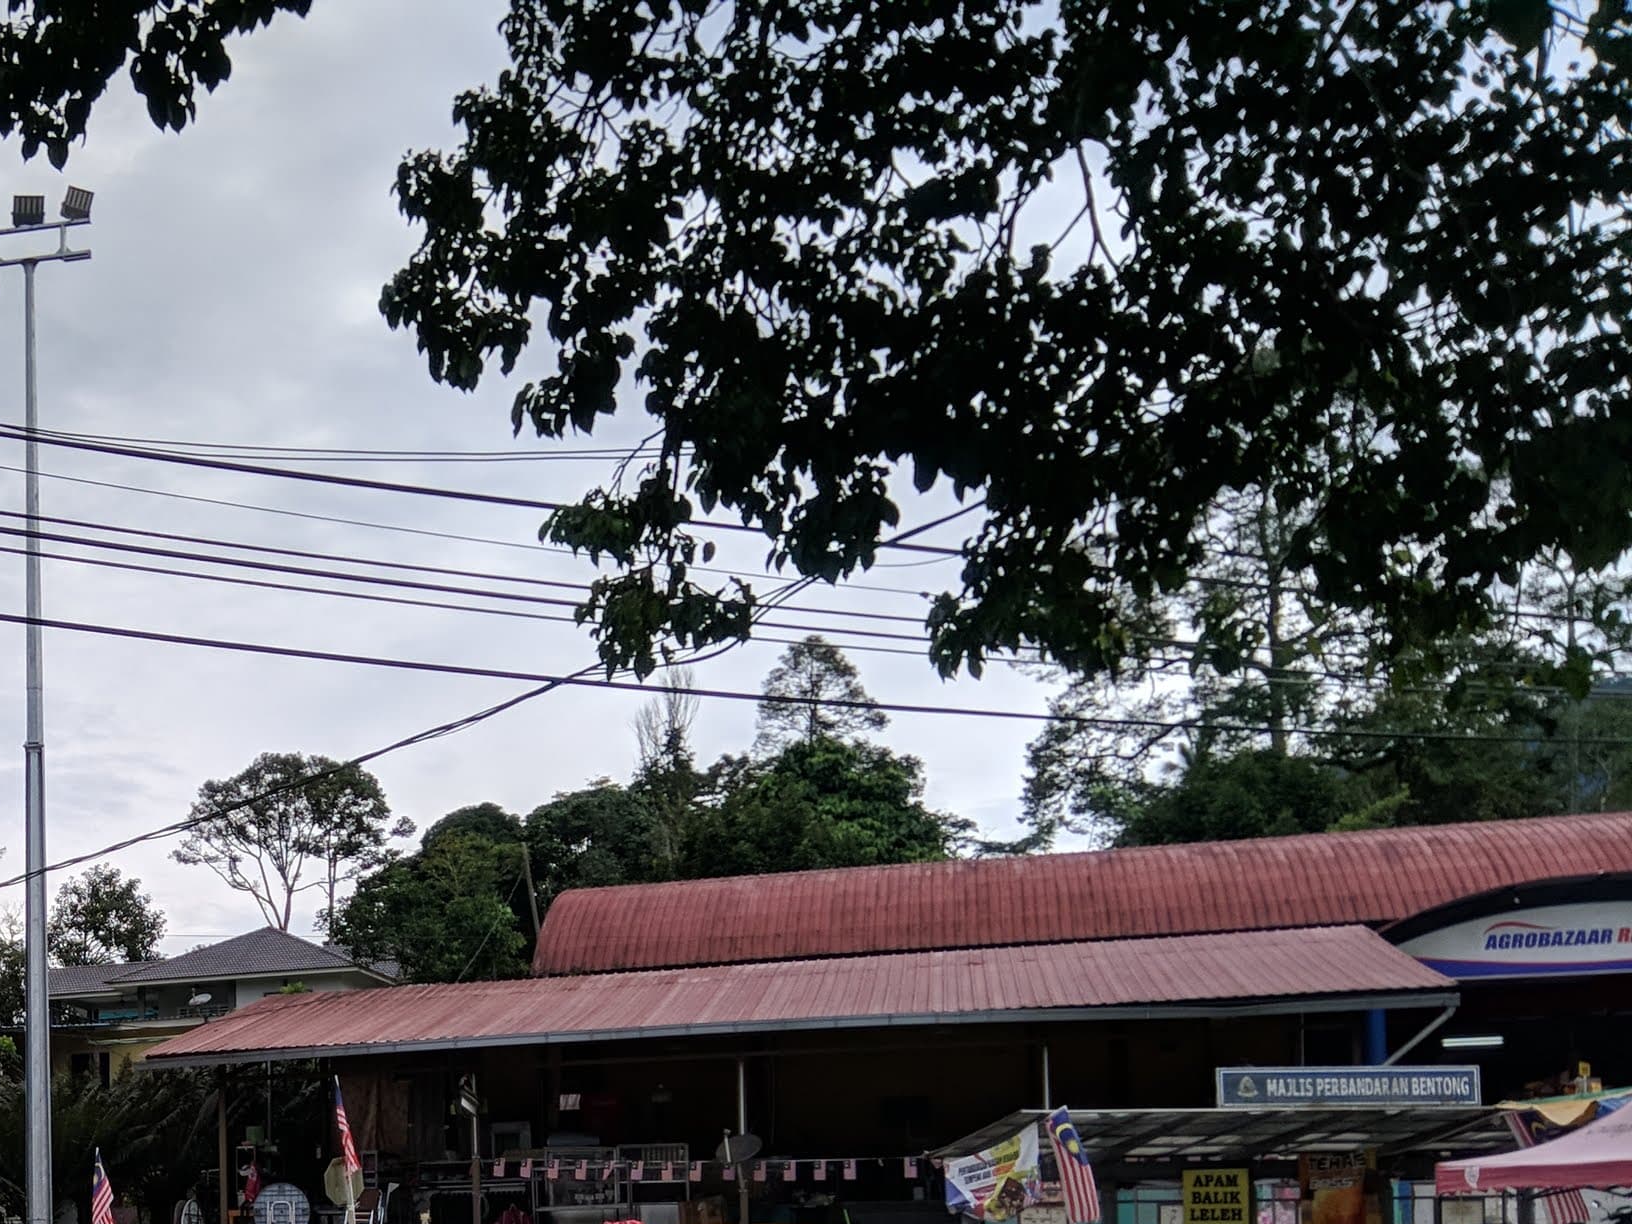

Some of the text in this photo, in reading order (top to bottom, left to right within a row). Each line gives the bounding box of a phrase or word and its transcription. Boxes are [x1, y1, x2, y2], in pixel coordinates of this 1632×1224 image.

[1485, 928, 1613, 950] AGROBAZAAR
[1267, 1076, 1469, 1096] MAJLIS PERBANDARAN BENTONG
[1193, 1174, 1239, 1187] APAM
[1191, 1191, 1241, 1204] BALIK
[1190, 1208, 1243, 1221] LELEH
